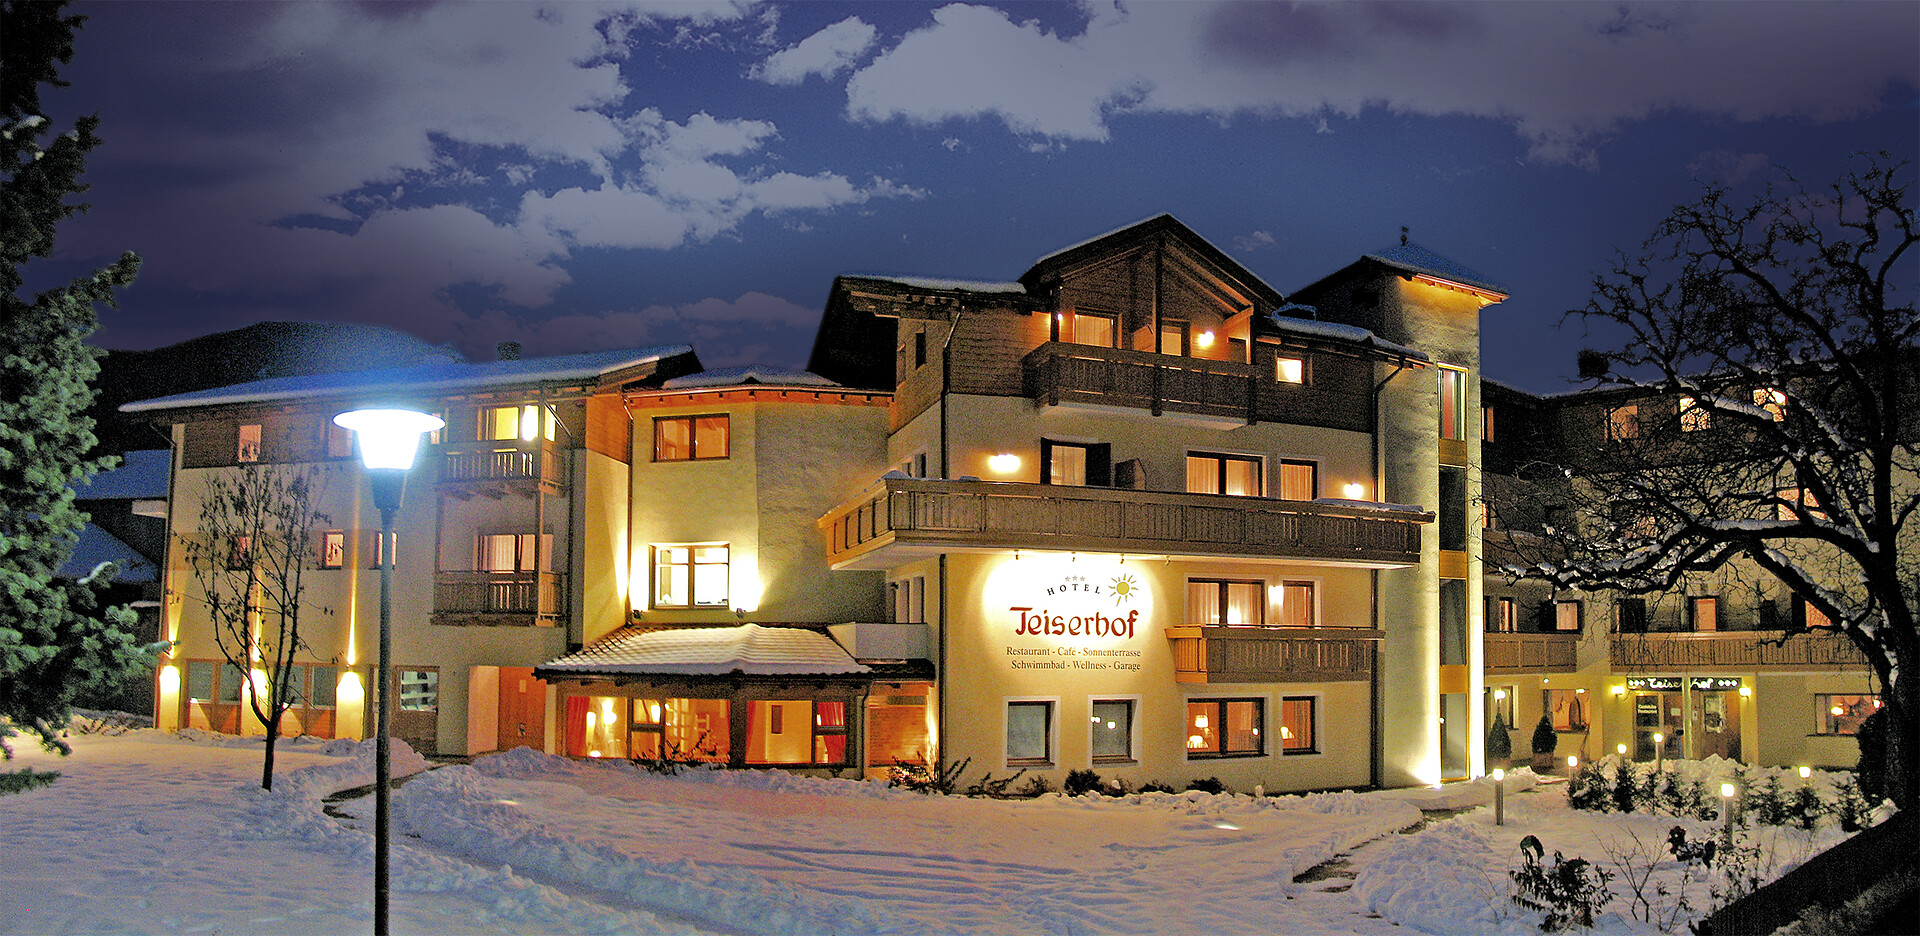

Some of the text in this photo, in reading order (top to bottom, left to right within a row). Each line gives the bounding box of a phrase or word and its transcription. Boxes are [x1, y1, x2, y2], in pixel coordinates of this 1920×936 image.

[1047, 583, 1101, 596] HOTEL
[1009, 606, 1139, 639] Teiserhof
[1006, 646, 1050, 656] Restaurant
[1057, 646, 1077, 656] Café
[1083, 647, 1142, 657] Sonnenterrasse
[1011, 660, 1066, 670] Schwimmbad
[1072, 660, 1108, 670] Wellness
[1113, 660, 1141, 673] Garage
[1647, 677, 1715, 690] Teisehof
